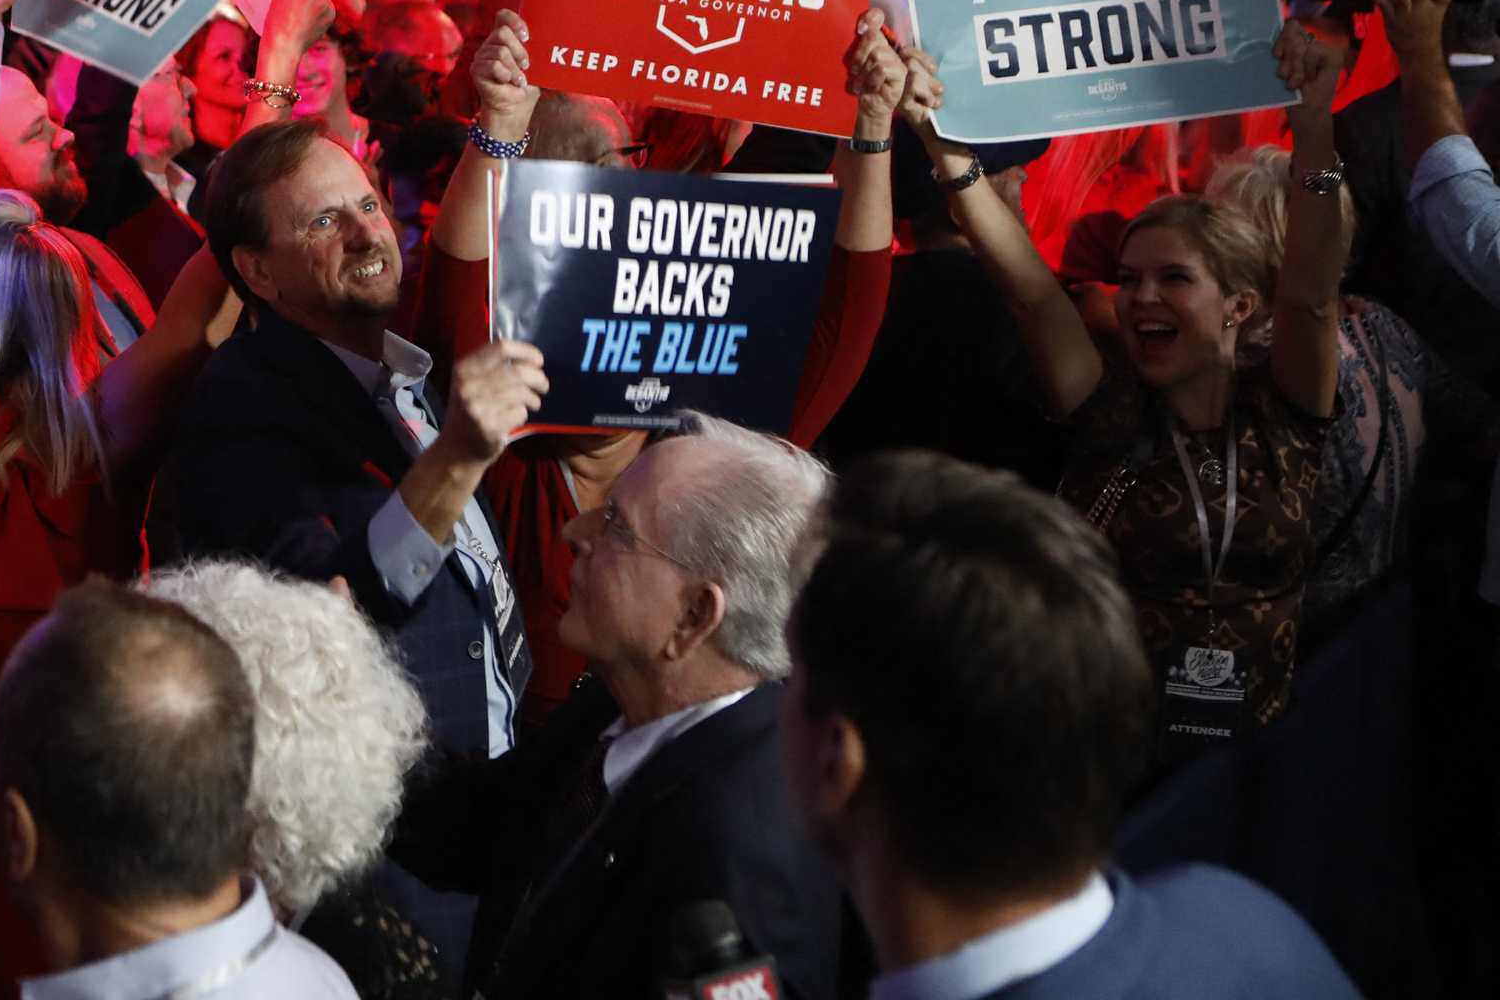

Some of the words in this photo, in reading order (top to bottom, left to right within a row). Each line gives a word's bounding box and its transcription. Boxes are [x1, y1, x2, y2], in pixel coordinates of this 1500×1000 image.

[550, 45, 619, 73] KEEP
[631, 59, 748, 95] FLORIDA
[762, 80, 823, 107] FREE
[529, 189, 615, 251] OUR
[627, 196, 817, 263] GOVERNOR
[612, 258, 735, 318] BACKS
[580, 318, 652, 373] THE
[651, 321, 748, 375] BLUE
[1169, 723, 1232, 738] ATTENDEE
